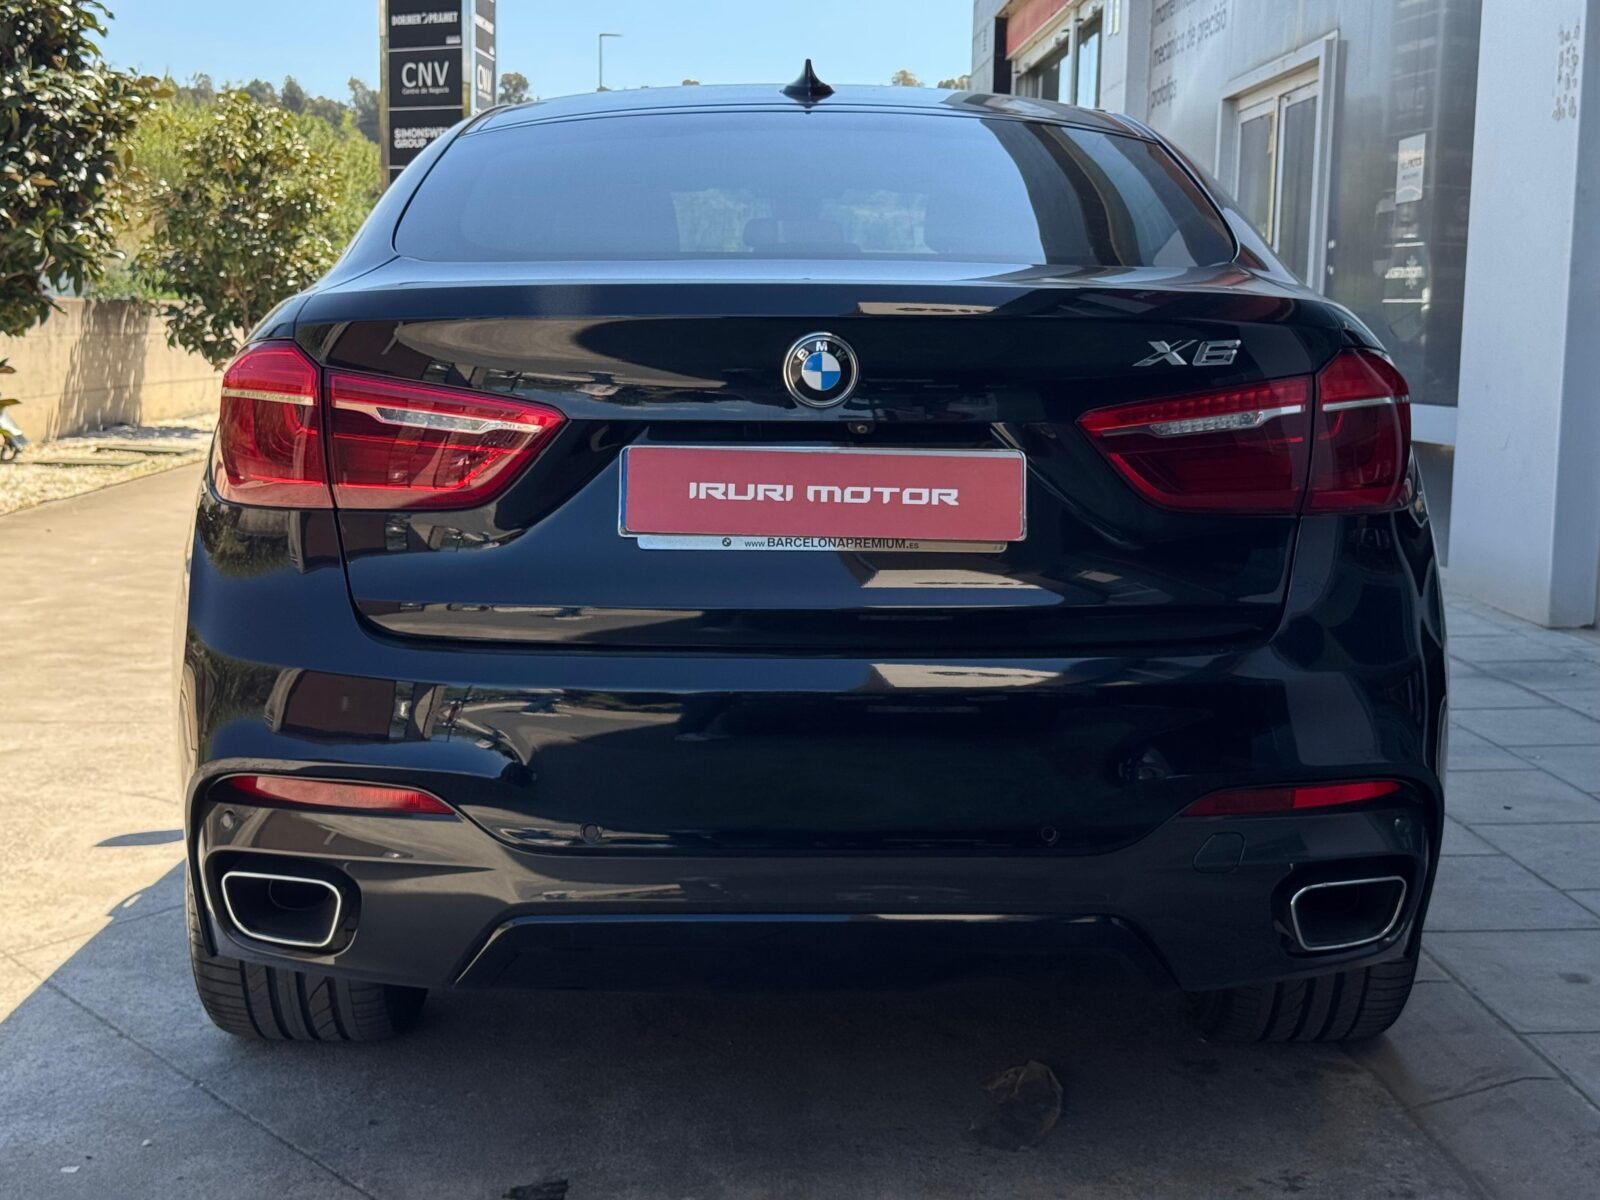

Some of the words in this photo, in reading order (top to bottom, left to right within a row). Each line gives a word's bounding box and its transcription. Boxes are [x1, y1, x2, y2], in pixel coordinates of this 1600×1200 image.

[401, 61, 449, 88] CNV
[1132, 339, 1241, 367] X6
[688, 482, 794, 502] IRURI
[806, 485, 959, 506] MOTOR
